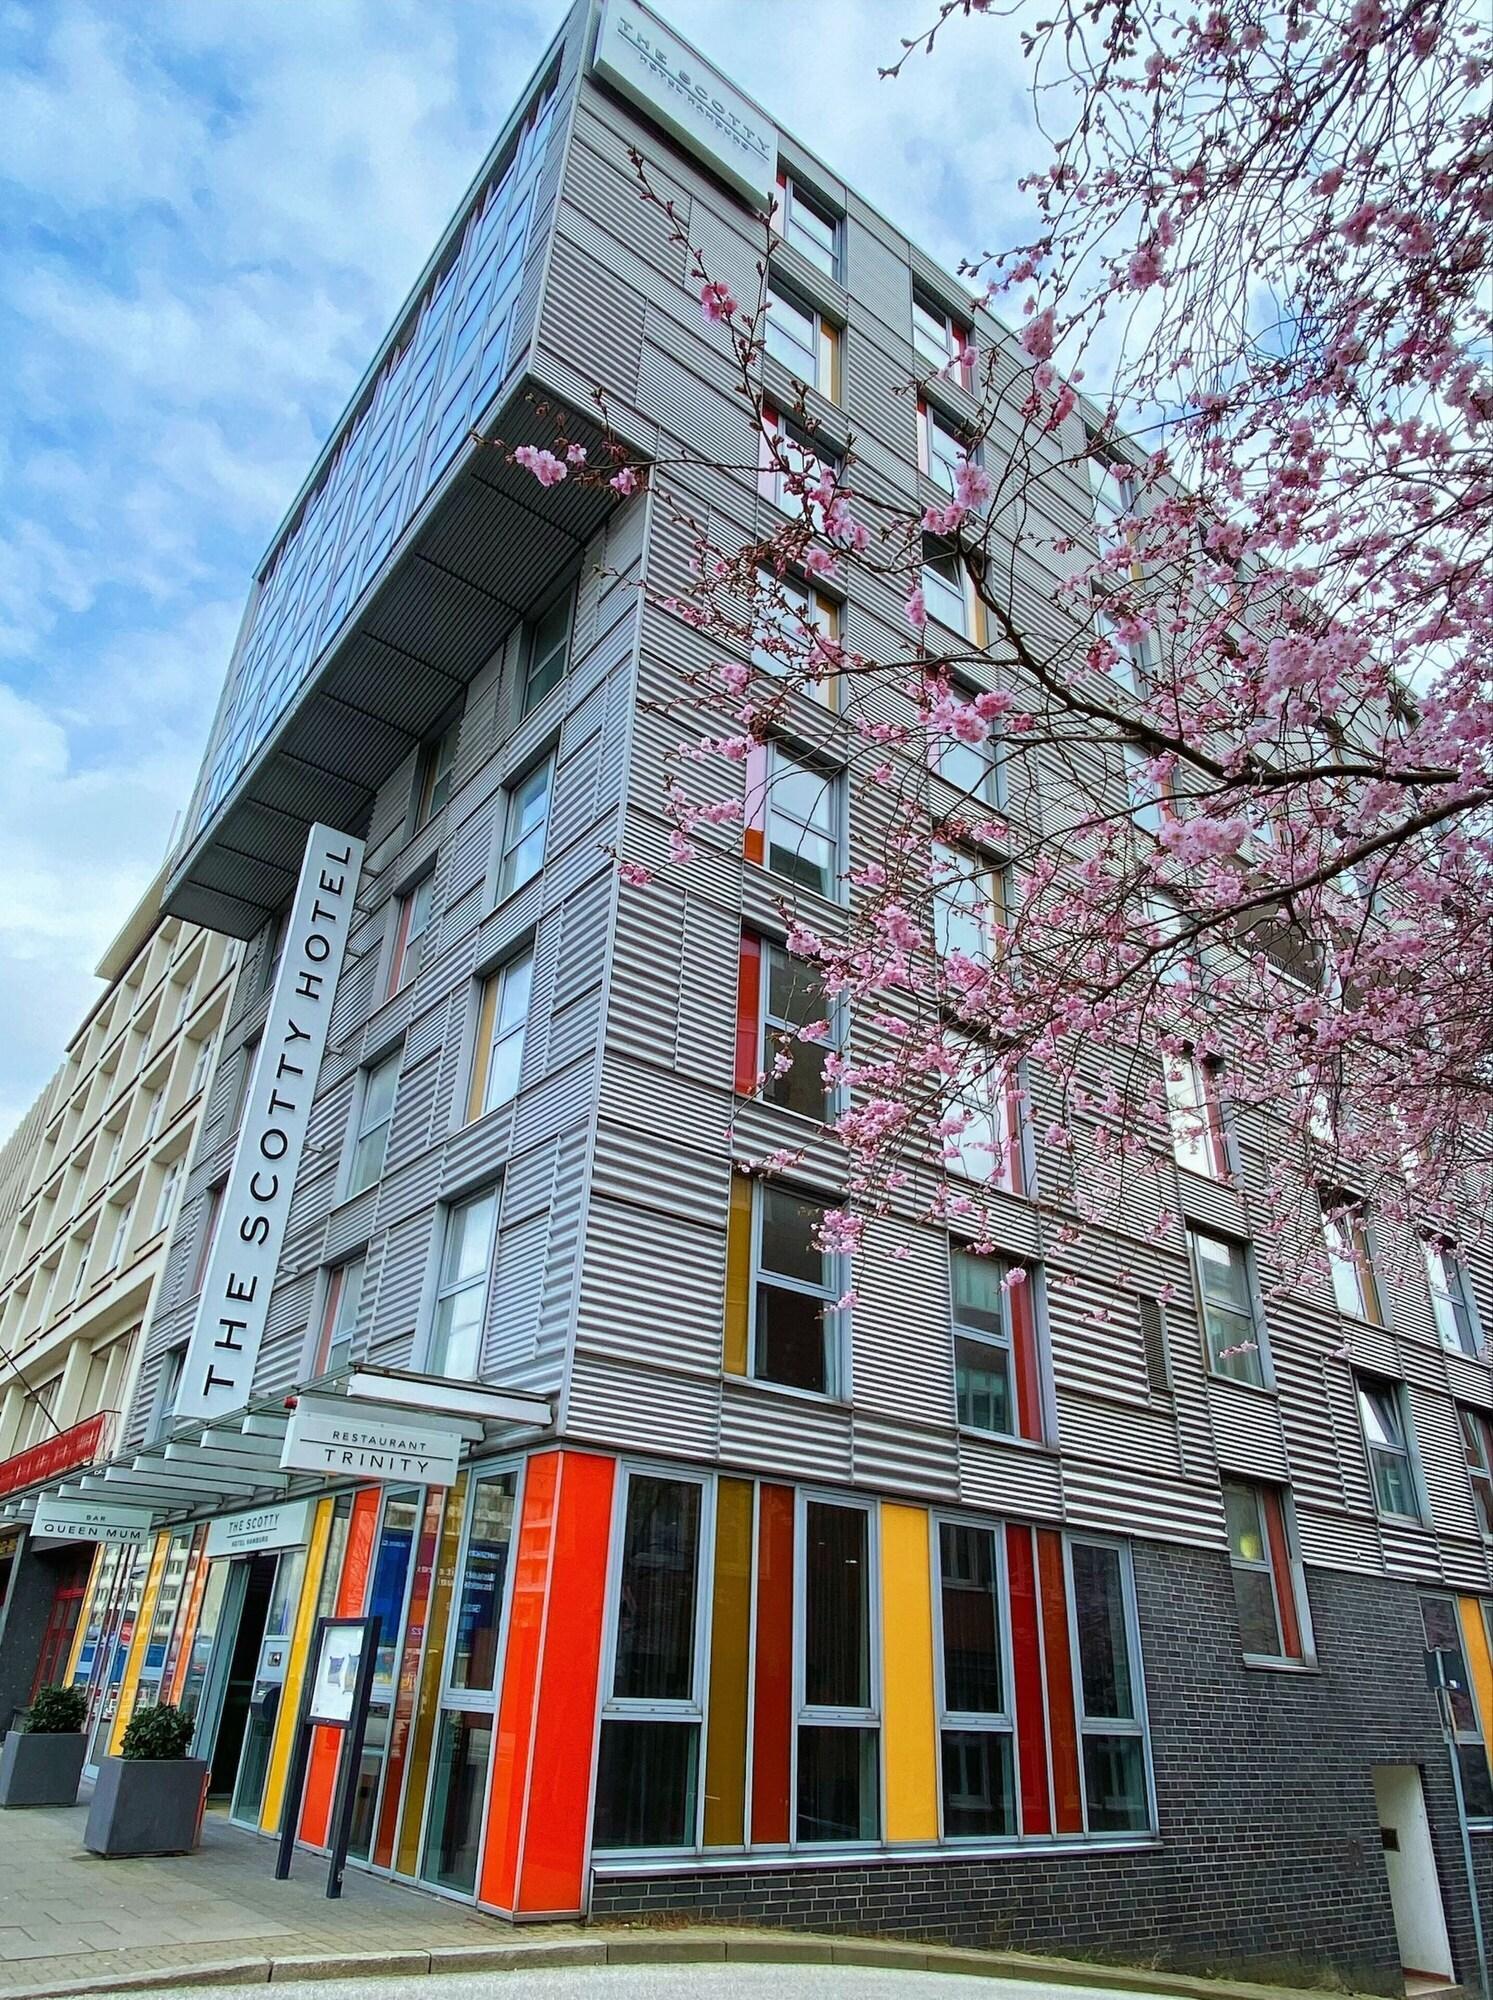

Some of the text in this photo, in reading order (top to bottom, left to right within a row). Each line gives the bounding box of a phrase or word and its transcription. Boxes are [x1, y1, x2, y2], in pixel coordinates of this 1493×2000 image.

[619, 17, 770, 151] THE SCOTTY
[639, 54, 684, 95] HOTEL
[203, 846, 351, 1396] THE SCOTTY HOTEL
[332, 1430, 427, 1451] RESTAURANT
[324, 1448, 430, 1473] TRINITY
[44, 1524, 141, 1539] QUEEN MUM
[228, 1513, 280, 1533] THE SCOTTY
